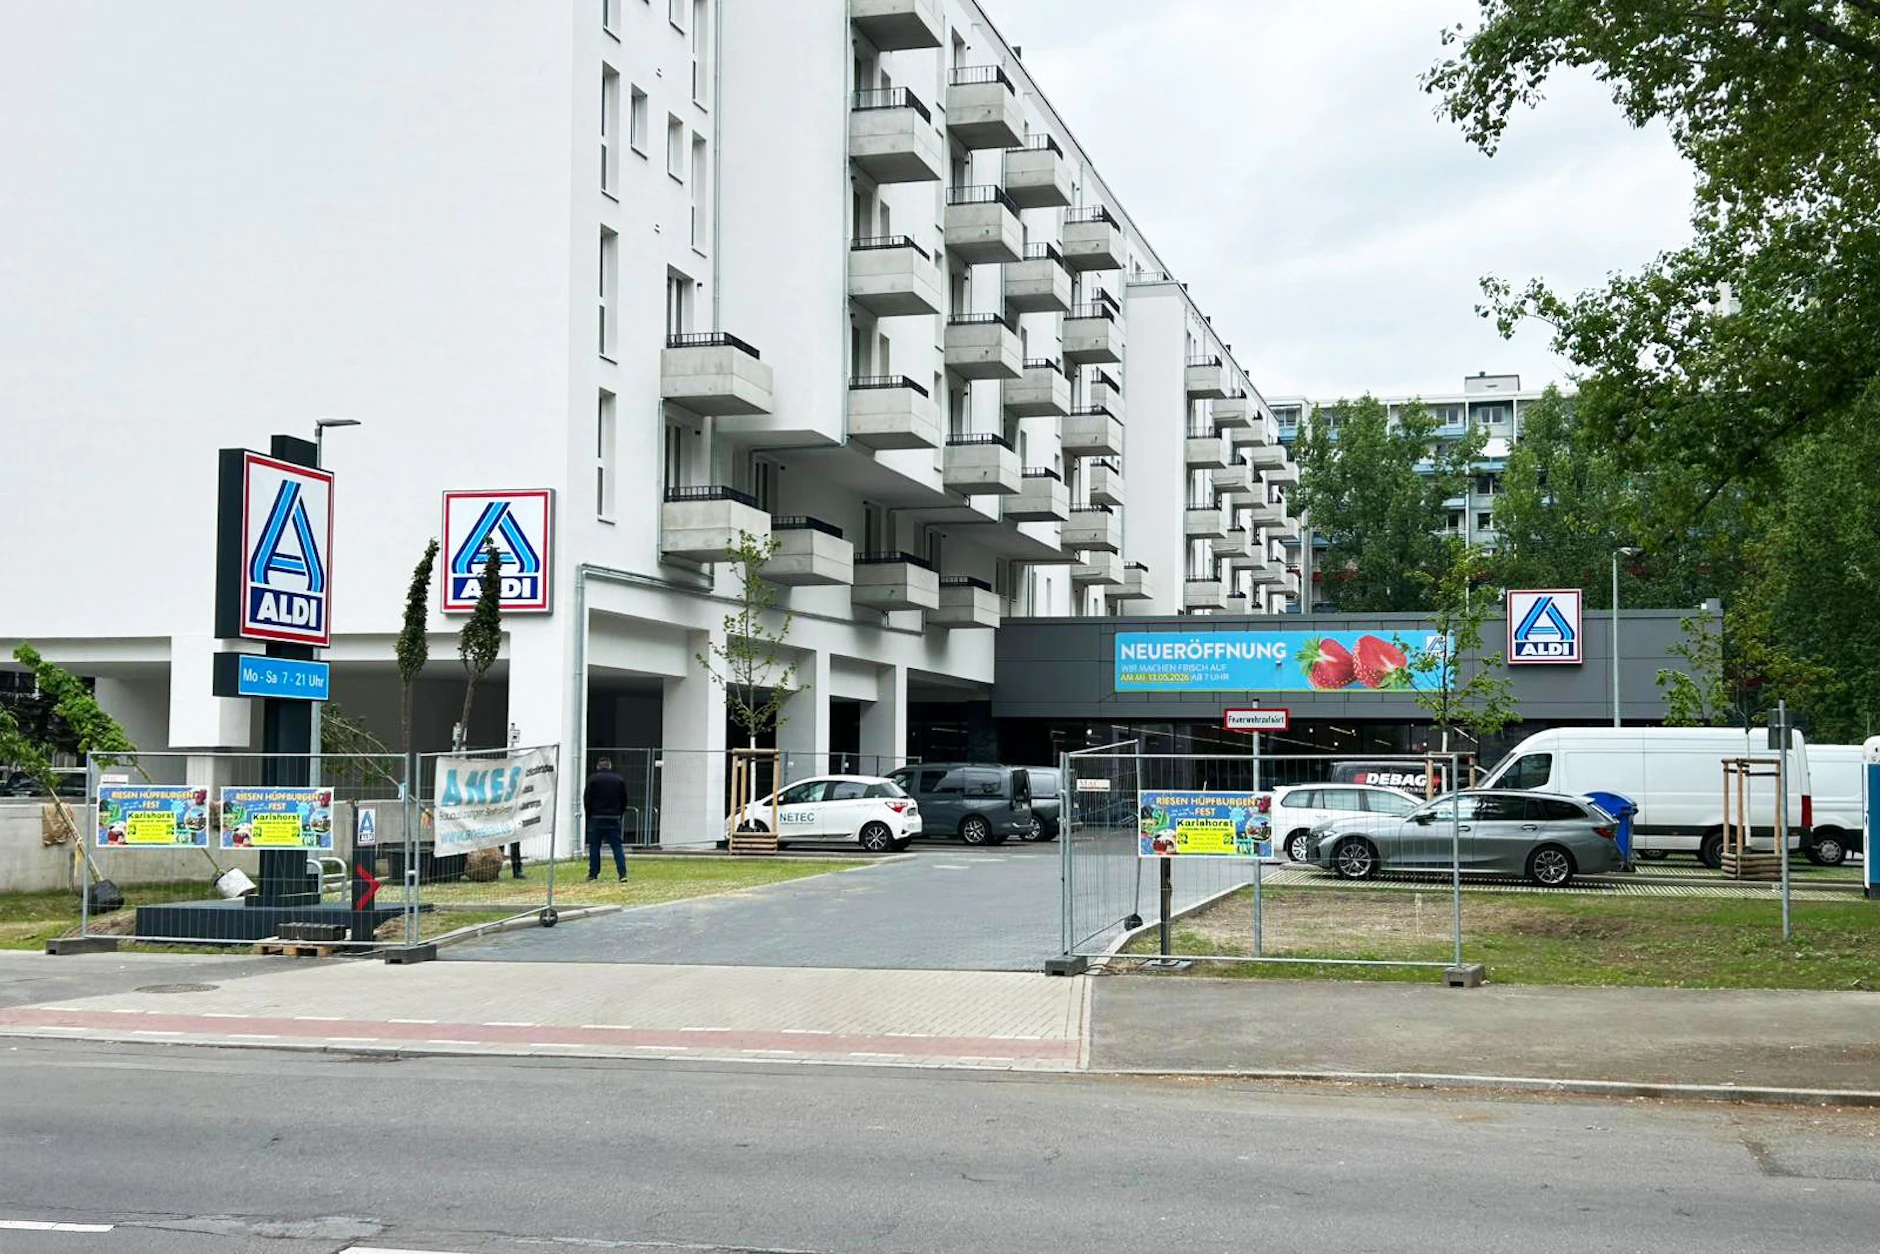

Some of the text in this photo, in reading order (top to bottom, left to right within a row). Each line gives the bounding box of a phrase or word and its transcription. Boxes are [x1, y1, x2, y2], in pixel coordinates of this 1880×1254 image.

[460, 578, 531, 598] ADI
[256, 591, 317, 628] ALDI
[1120, 639, 1287, 660] NEUERÖFFNUNG
[1520, 642, 1570, 656] ALDI
[1138, 664, 1176, 673] MACHEN
[1178, 664, 1208, 673] FRISCH
[1210, 663, 1227, 672] AUF
[243, 668, 258, 683] Mo
[266, 670, 277, 684] Sa
[295, 673, 305, 687] 21
[308, 674, 325, 688] Uhr
[1210, 674, 1229, 682] UHR
[1366, 772, 1428, 787] DEBAG
[128, 811, 175, 819] Karlshorst
[253, 813, 300, 821] Karlshorst
[779, 812, 815, 821] NETEC
[1176, 819, 1234, 828] Karlshorst
